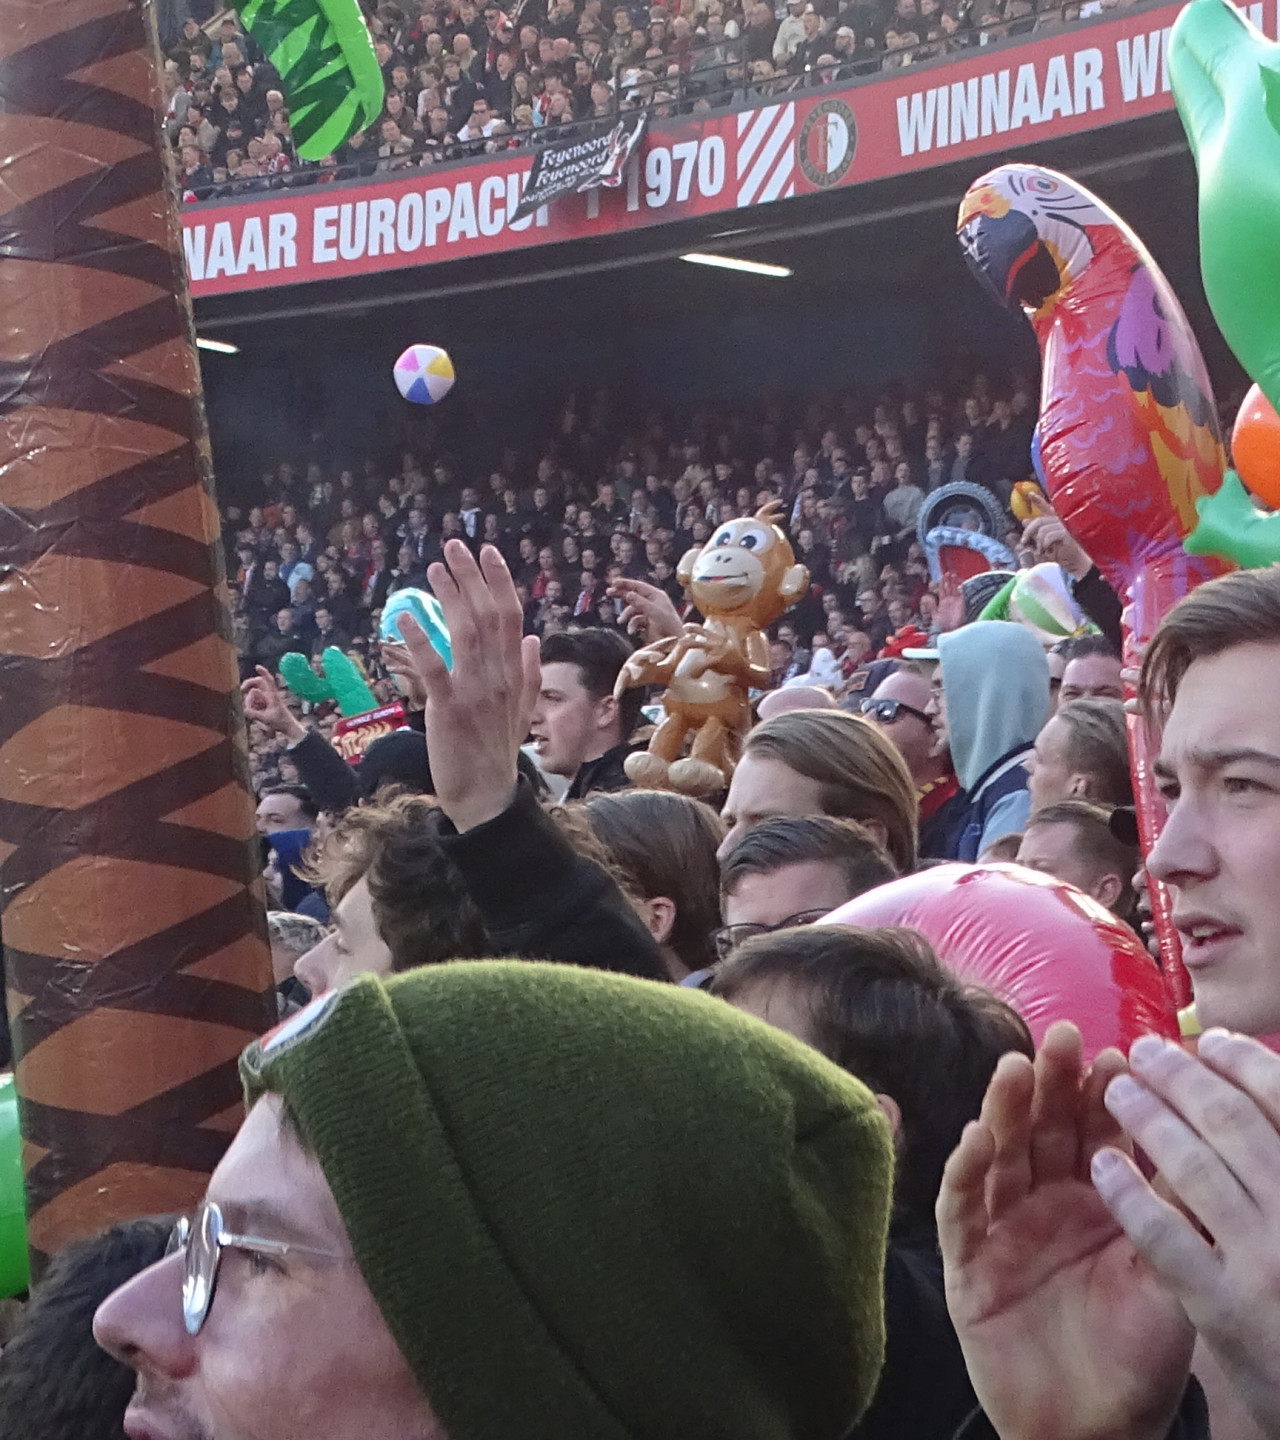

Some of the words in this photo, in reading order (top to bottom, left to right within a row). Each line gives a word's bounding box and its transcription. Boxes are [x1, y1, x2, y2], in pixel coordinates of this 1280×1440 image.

[895, 48, 1105, 157] WINNAAR
[182, 212, 298, 281] NAAR
[312, 170, 549, 264] EUROPACU
